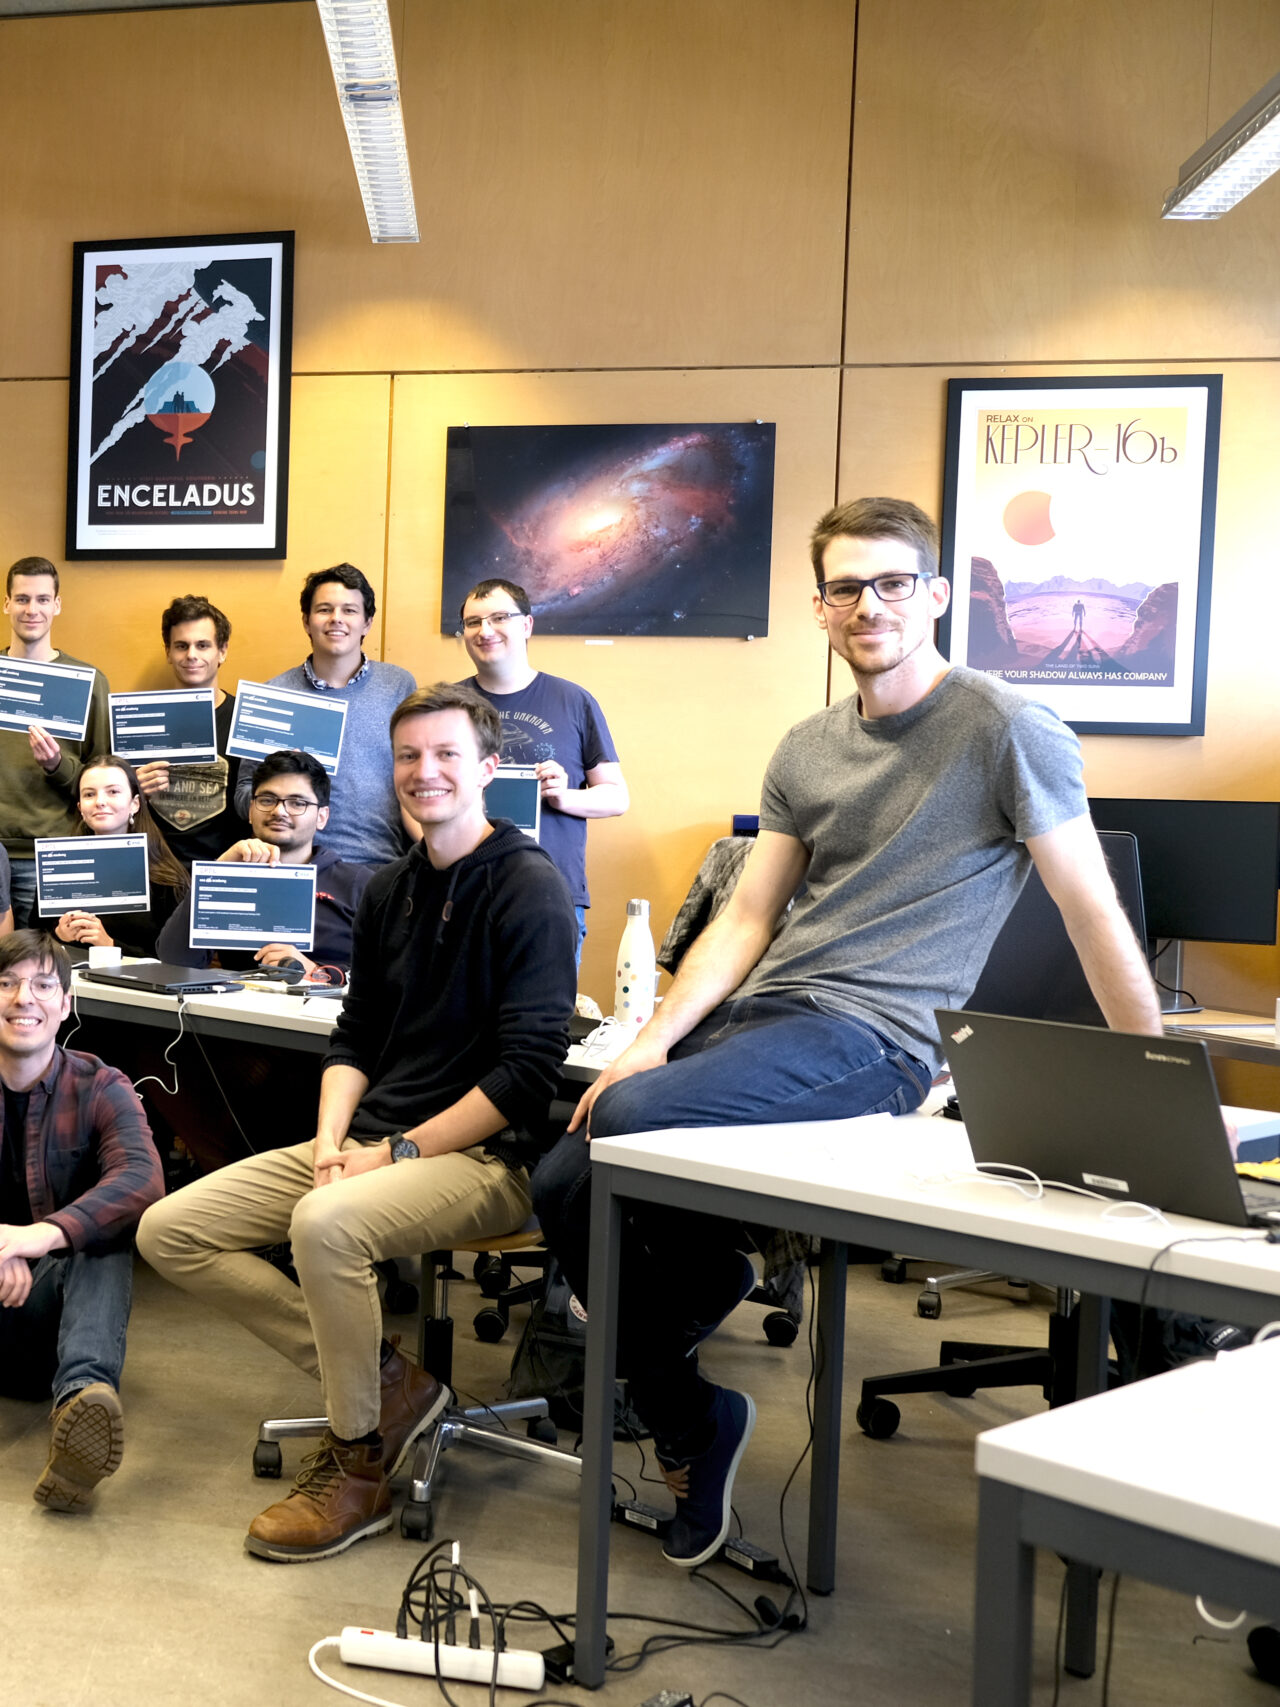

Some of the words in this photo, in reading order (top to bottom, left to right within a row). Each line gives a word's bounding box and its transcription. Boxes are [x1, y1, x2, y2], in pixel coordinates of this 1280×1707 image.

[986, 414, 1020, 423] RELAX
[97, 483, 256, 507] ENCELADUS
[1005, 670, 1028, 679] YOUR
[1029, 670, 1066, 679] SHADOW
[1068, 671, 1103, 680] ALWAYS
[1104, 672, 1122, 680] HAS
[1123, 672, 1168, 681] COMPANY
[499, 711, 510, 720] HE
[513, 711, 554, 735] UNKNOWN
[173, 780, 196, 793] AND
[200, 781, 220, 794] SEA
